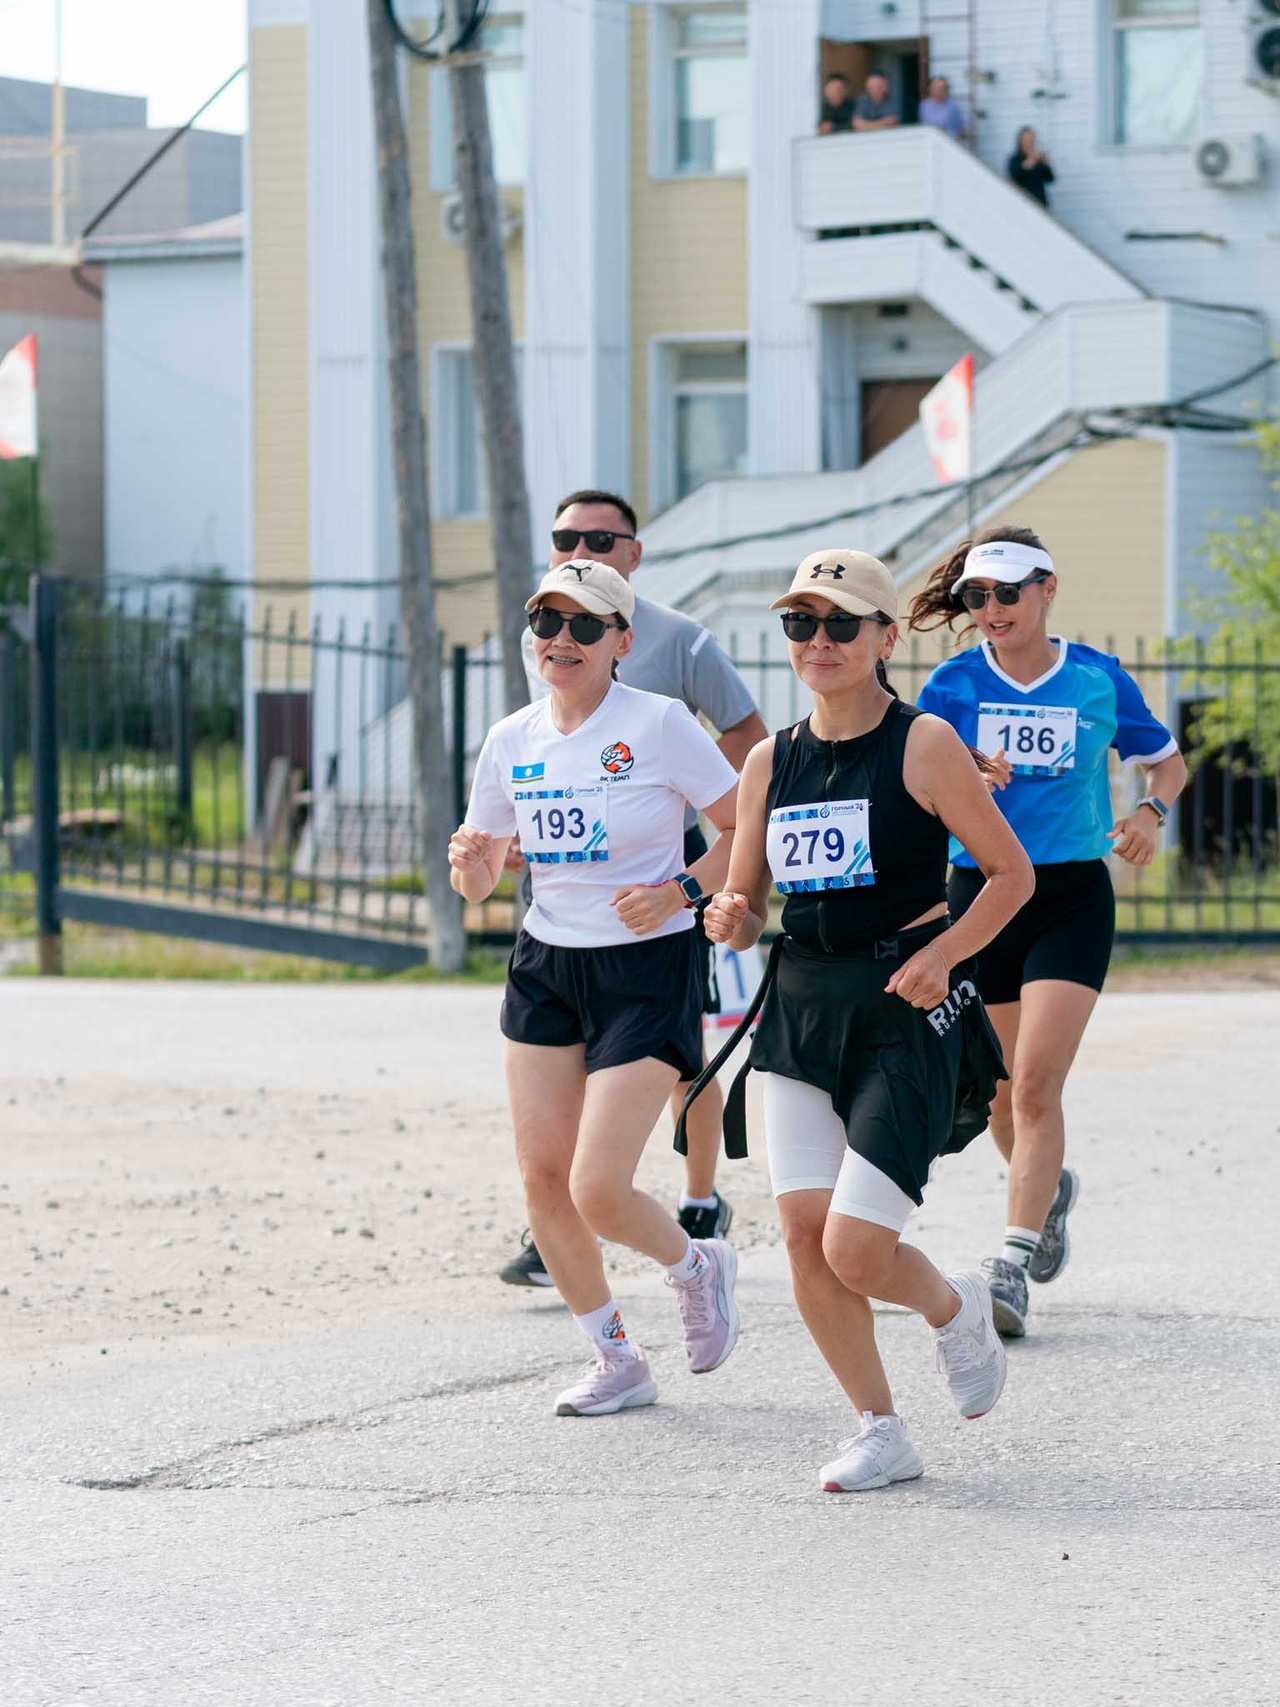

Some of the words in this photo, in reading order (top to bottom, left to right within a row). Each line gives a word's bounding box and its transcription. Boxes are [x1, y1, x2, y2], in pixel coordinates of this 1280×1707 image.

[997, 724, 1056, 755] 186
[532, 807, 586, 840] 193
[782, 827, 845, 868] 279
